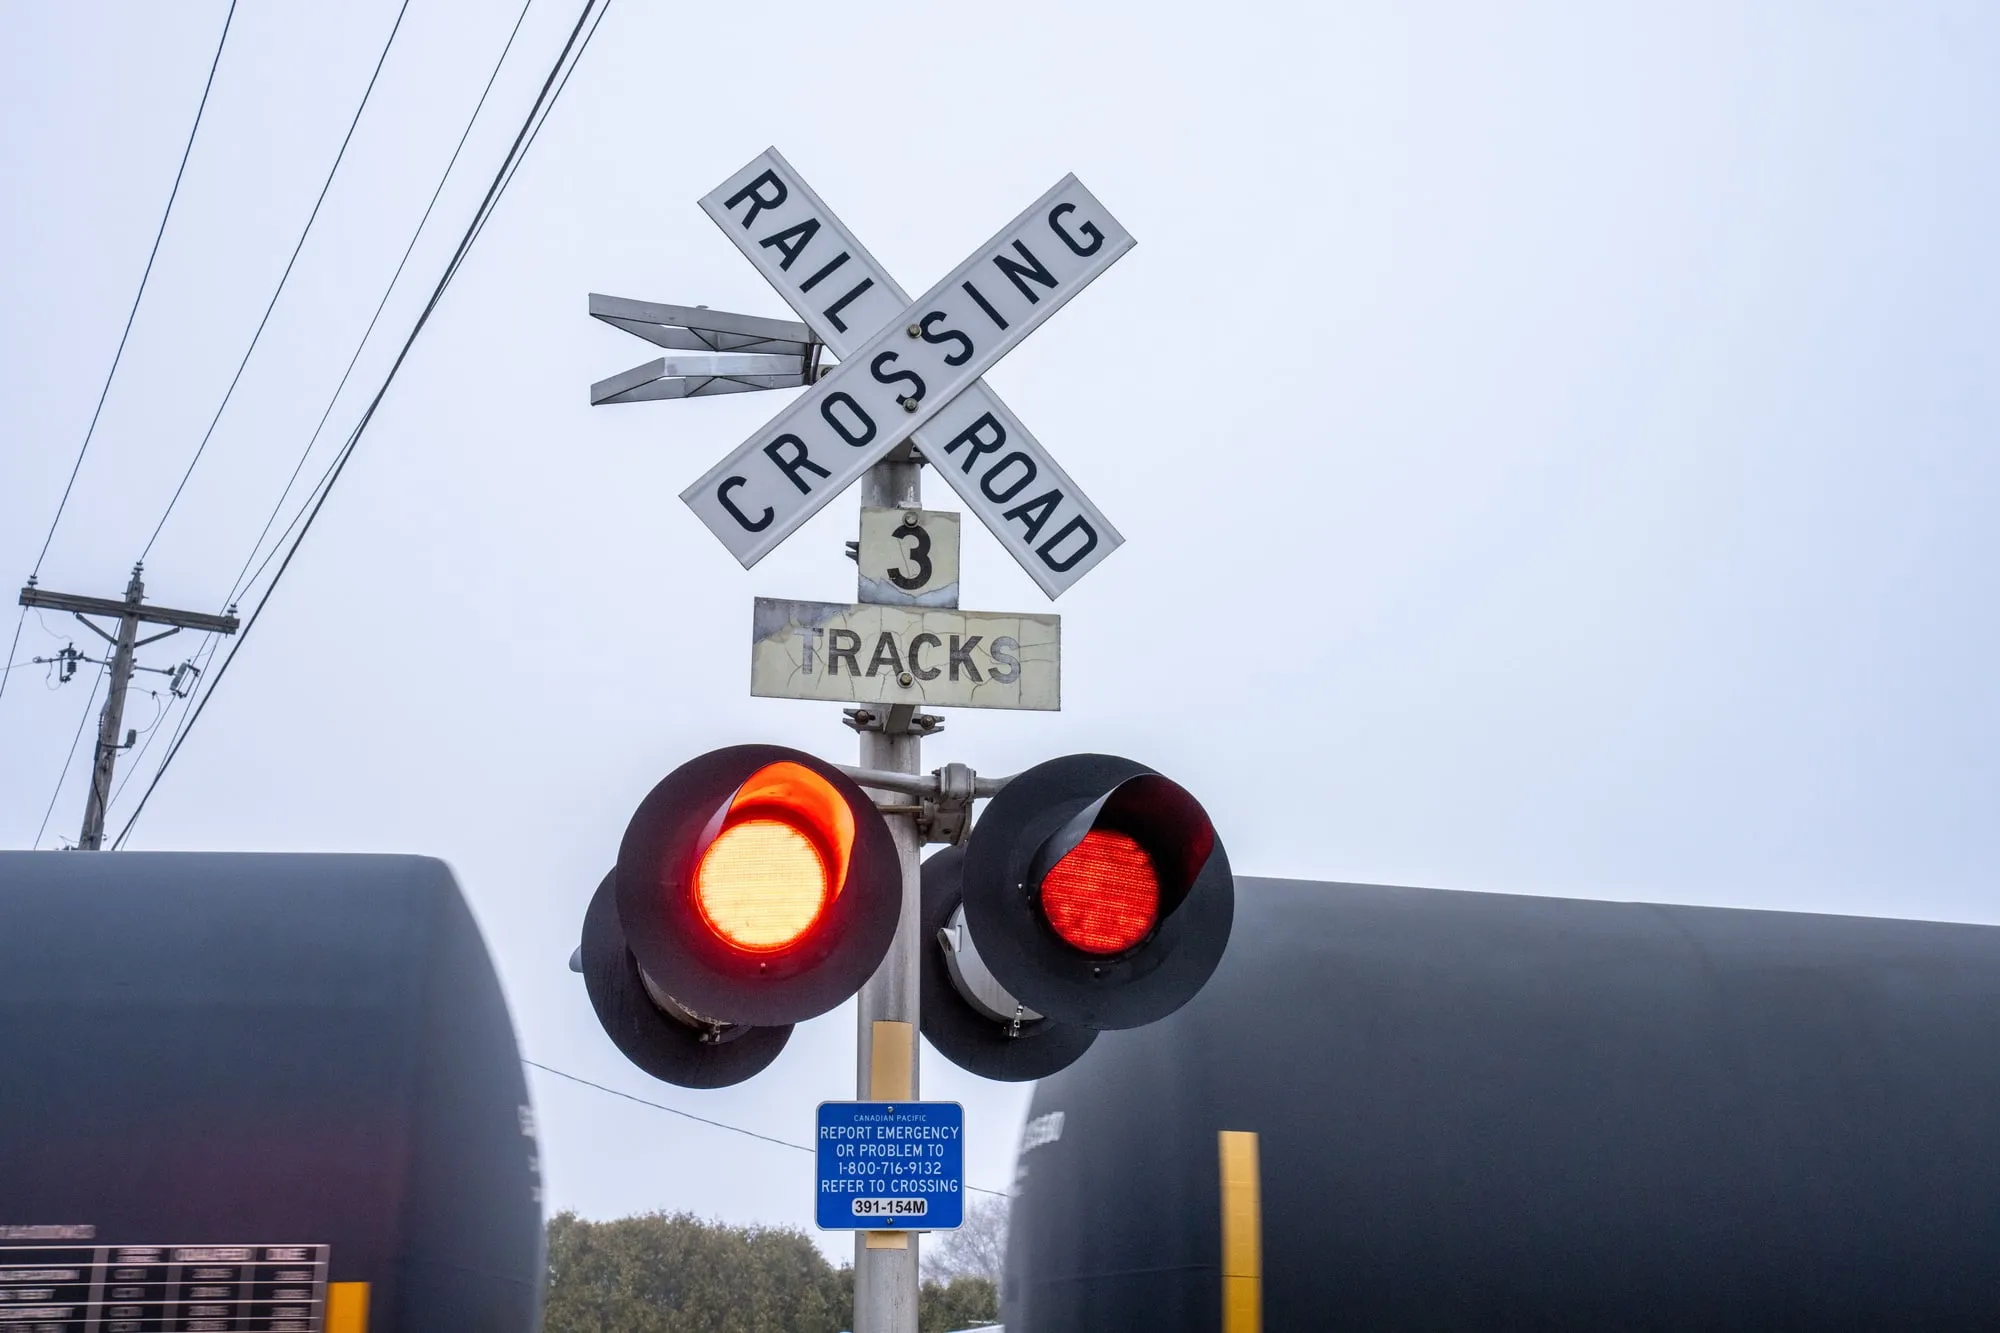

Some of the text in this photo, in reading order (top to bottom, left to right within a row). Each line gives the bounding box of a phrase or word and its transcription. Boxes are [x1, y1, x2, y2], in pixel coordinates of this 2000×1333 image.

[716, 202, 1106, 533] CROSSING
[723, 168, 1099, 573] RAIL ROAD
[886, 524, 933, 591] 3
[793, 626, 1022, 685] TRACKS
[853, 1114, 927, 1122] CANADIAN PACIFIC
[820, 1126, 960, 1140] REPORT EMERGENCY
[836, 1144, 944, 1157] OR PROBLEM TO
[838, 1161, 942, 1175] 1-800-716-9132
[821, 1179, 959, 1193] REFER TO CROSSING
[855, 1200, 926, 1214] 391-154M
